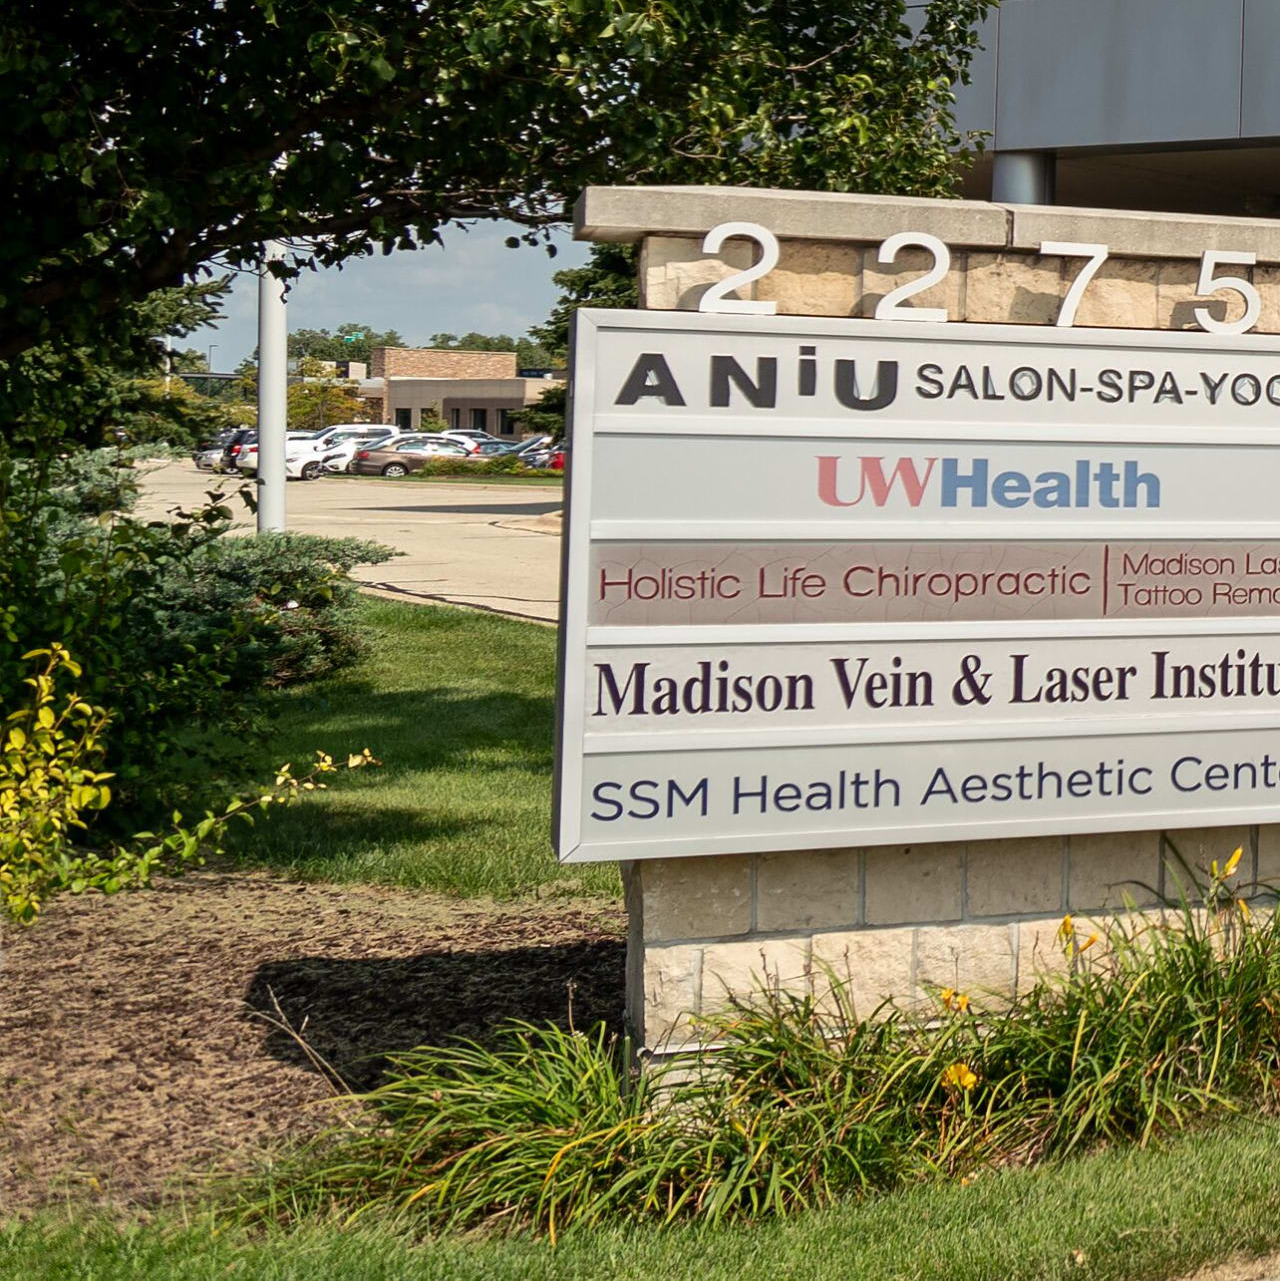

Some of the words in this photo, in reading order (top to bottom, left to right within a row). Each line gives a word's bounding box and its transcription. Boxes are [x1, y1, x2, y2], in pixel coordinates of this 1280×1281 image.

[599, 566, 741, 601] Holistic
[758, 565, 827, 600] Life
[843, 560, 1092, 602] Chiropractic
[1122, 550, 1236, 577] Madison
[1117, 580, 1203, 607] Tattoo
[591, 659, 815, 717] Madison
[830, 654, 935, 710] Vein
[951, 653, 993, 706] &
[1010, 651, 1138, 705] Laser
[590, 777, 709, 822] SSM
[732, 768, 902, 816] Health
[920, 758, 1154, 805] Aesthetic
